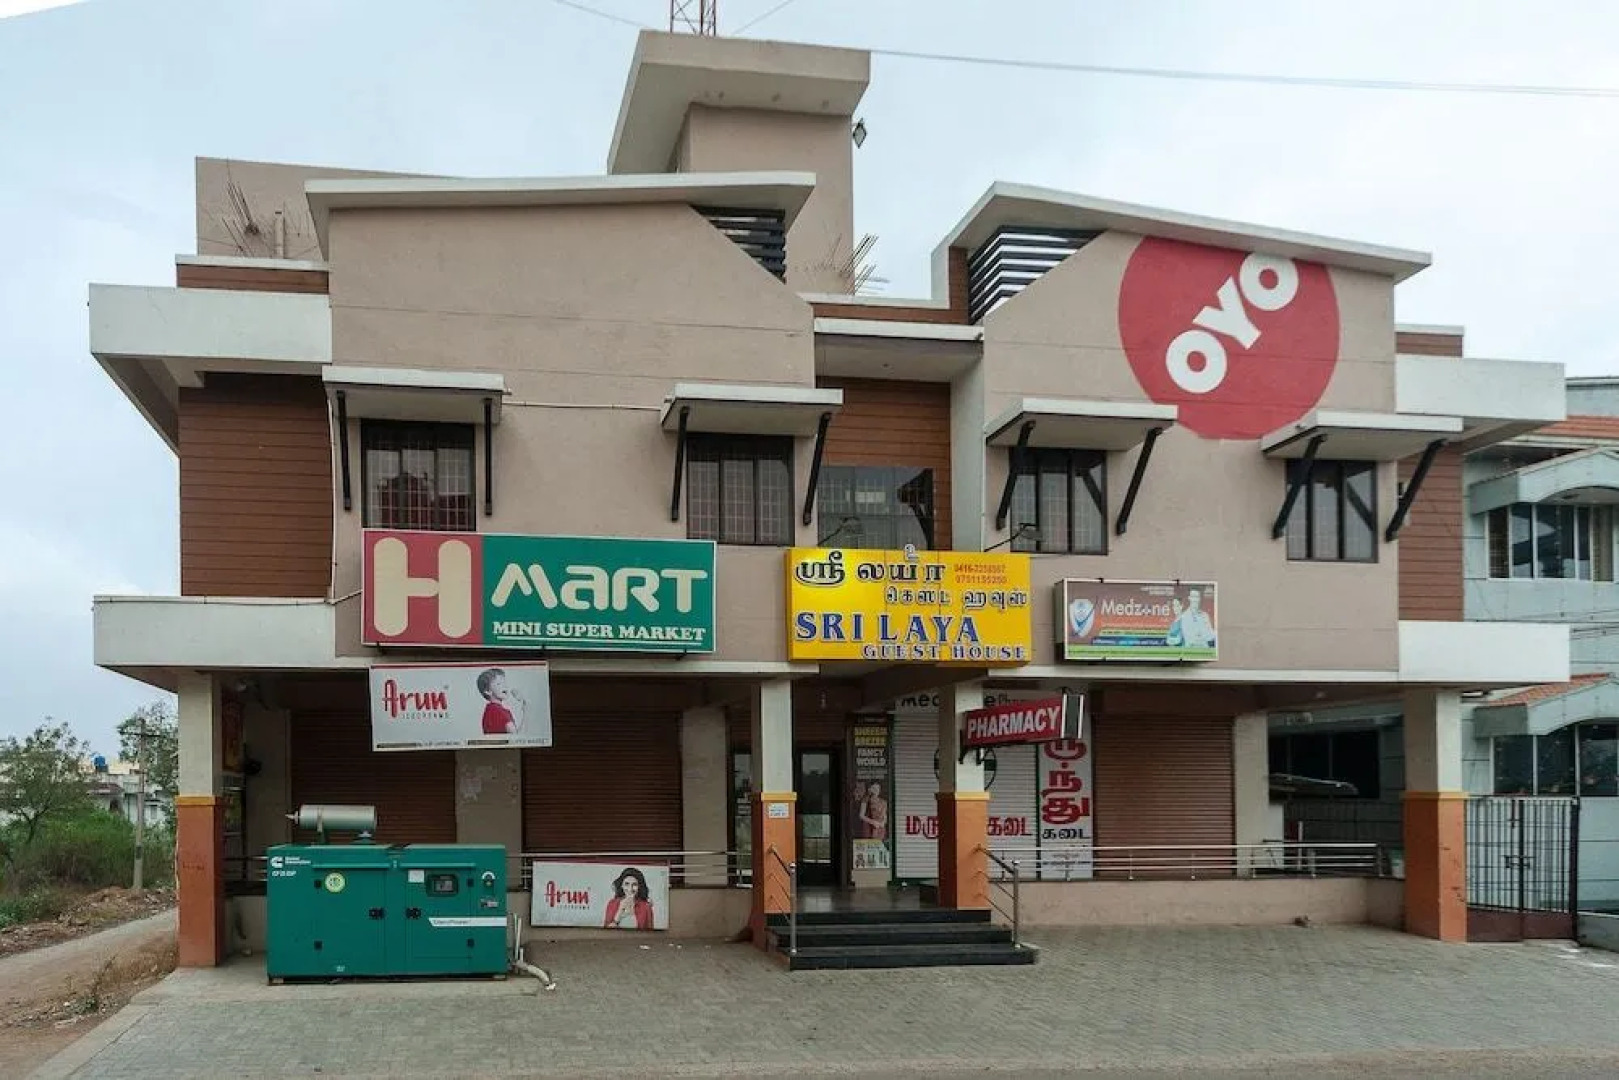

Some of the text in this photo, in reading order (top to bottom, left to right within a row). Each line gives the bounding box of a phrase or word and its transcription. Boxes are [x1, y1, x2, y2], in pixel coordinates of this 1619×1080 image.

[1165, 252, 1299, 394] OYO
[373, 537, 472, 639] H
[493, 621, 707, 641] MINI SUPER MARKET
[795, 612, 980, 643] SRI LAYA
[863, 644, 1025, 660] GUEST HOUSE
[382, 680, 447, 718] Arun
[967, 706, 1060, 739] PHARMACY
[544, 880, 589, 908] Arun
